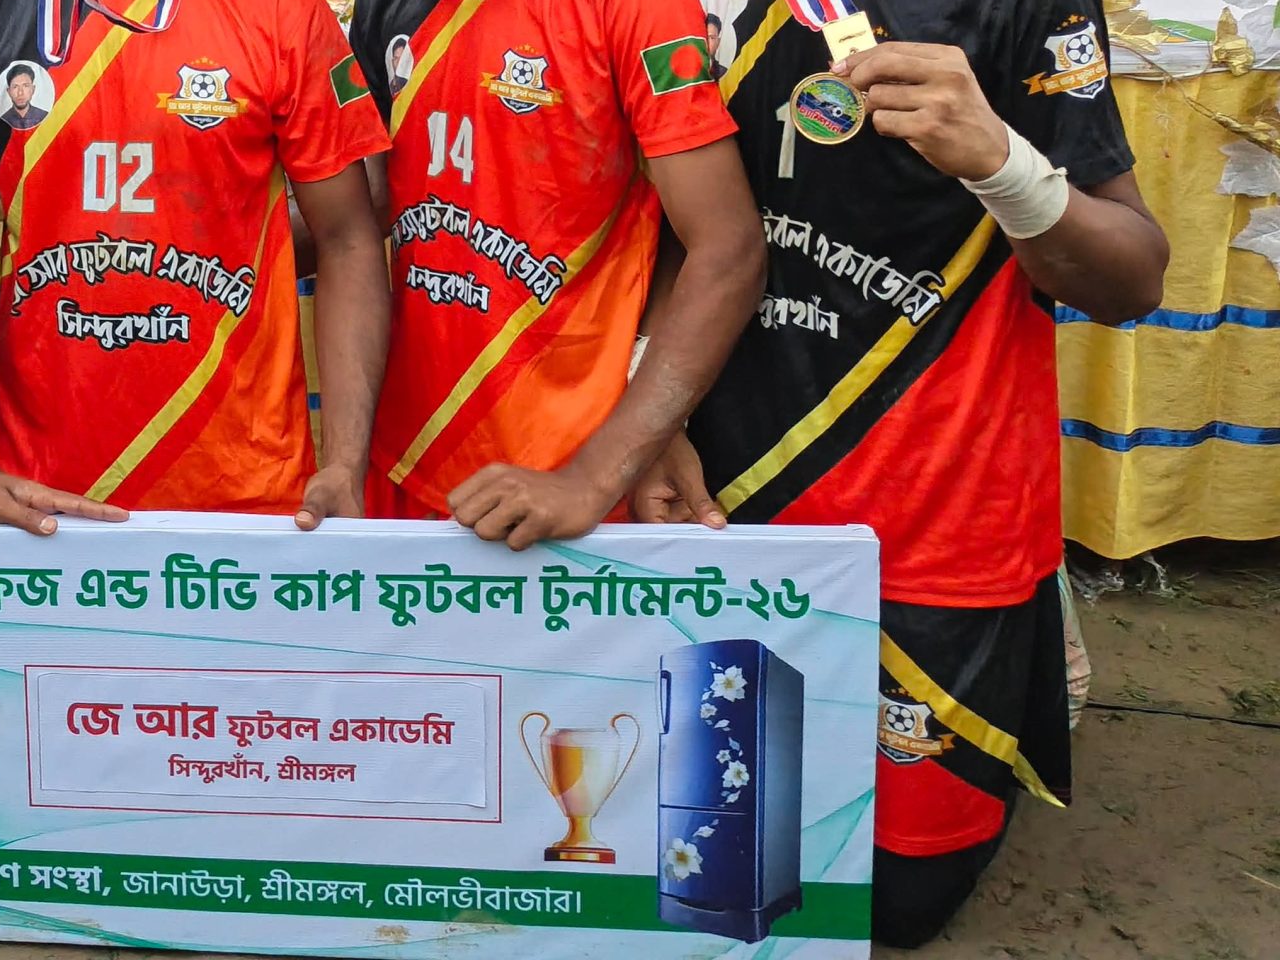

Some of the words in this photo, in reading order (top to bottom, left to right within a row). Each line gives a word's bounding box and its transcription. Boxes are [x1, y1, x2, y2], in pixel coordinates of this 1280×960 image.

[82, 141, 155, 213] 02
[426, 111, 474, 184] 14
[69, 232, 154, 284] ফুটবল
[156, 246, 253, 314] একাডেমি
[471, 220, 566, 303] একাডেমি
[813, 232, 944, 324] একাডেমি
[75, 569, 151, 610] এন্ড
[161, 553, 261, 611] টিভি
[271, 569, 365, 612] কাপ
[376, 563, 528, 627] ফুটবল
[538, 564, 811, 632] টুর্নামেন্ট-২৬
[67, 701, 123, 736] জে
[133, 702, 218, 740] আর
[227, 710, 320, 747] ফুটবল
[328, 713, 455, 745] একাডেমি
[276, 755, 357, 782] শ্রীমঙ্গল
[28, 864, 112, 897] সংস্থা,
[119, 869, 253, 904] জানাউড়া,
[259, 868, 374, 909] শ্রীমঙ্গল,
[382, 877, 582, 914] মৌলভীবাজার।
